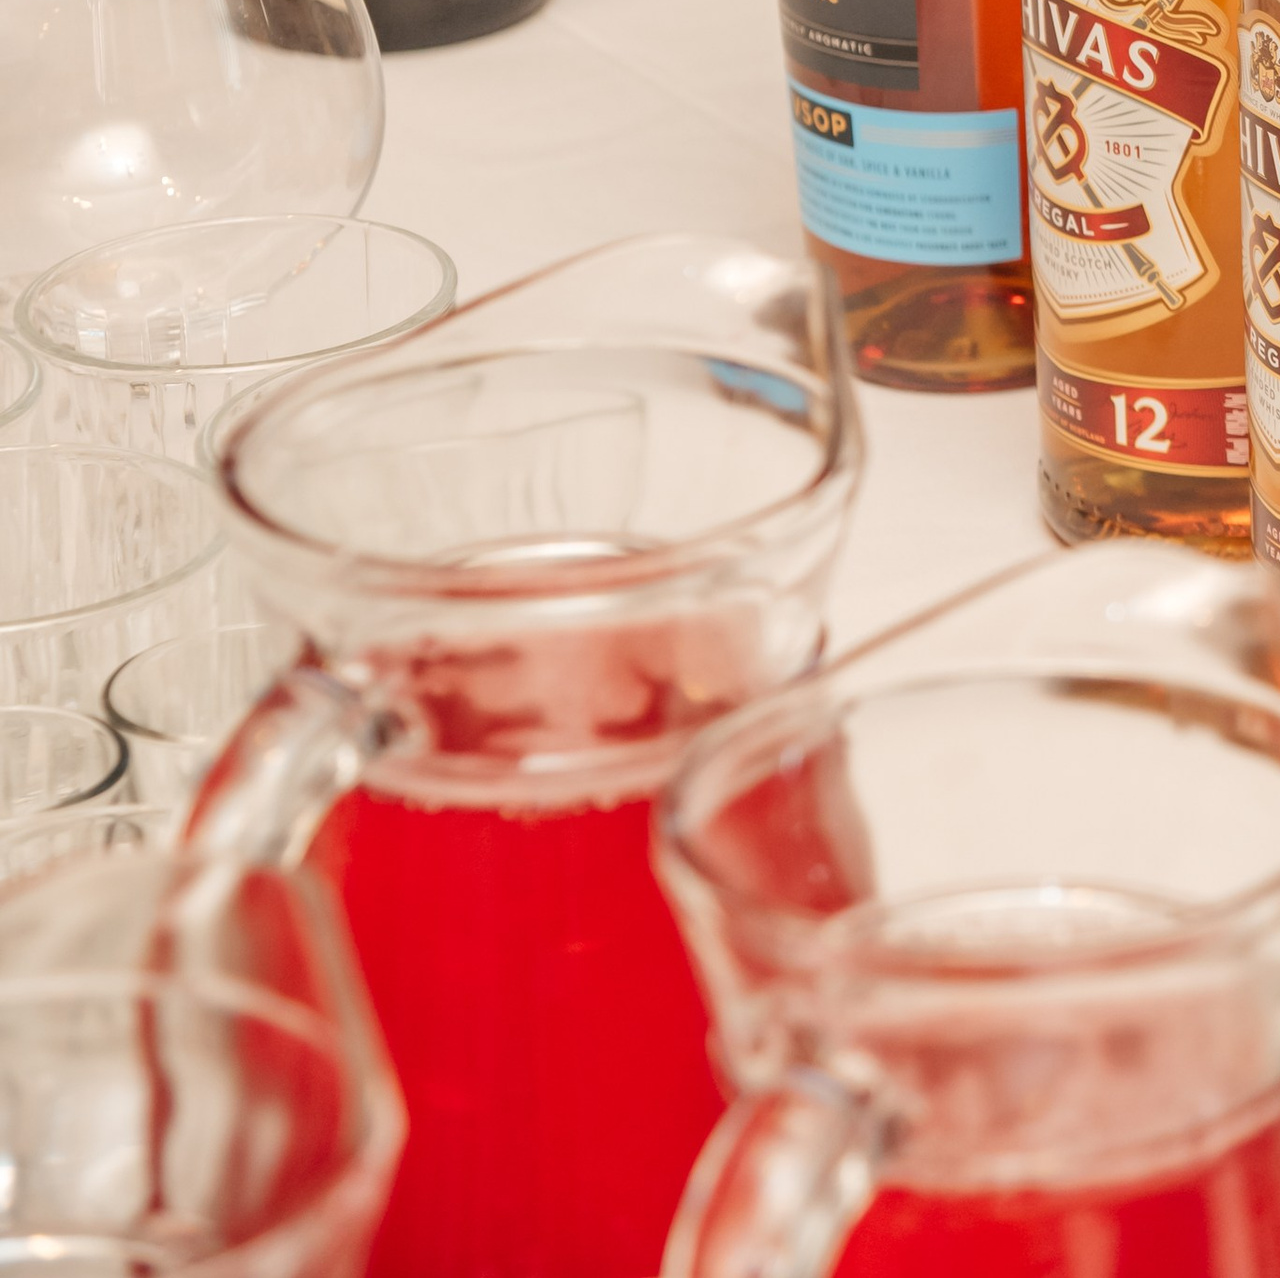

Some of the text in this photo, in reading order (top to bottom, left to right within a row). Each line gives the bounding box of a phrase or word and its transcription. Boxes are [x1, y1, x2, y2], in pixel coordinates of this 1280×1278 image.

[1104, 139, 1142, 160] 1801
[1033, 190, 1096, 238] REGAL
[1064, 251, 1113, 271] SCOTCH
[1052, 375, 1079, 399] AGED
[1051, 392, 1083, 422] YEARS
[1109, 393, 1172, 455] 12
